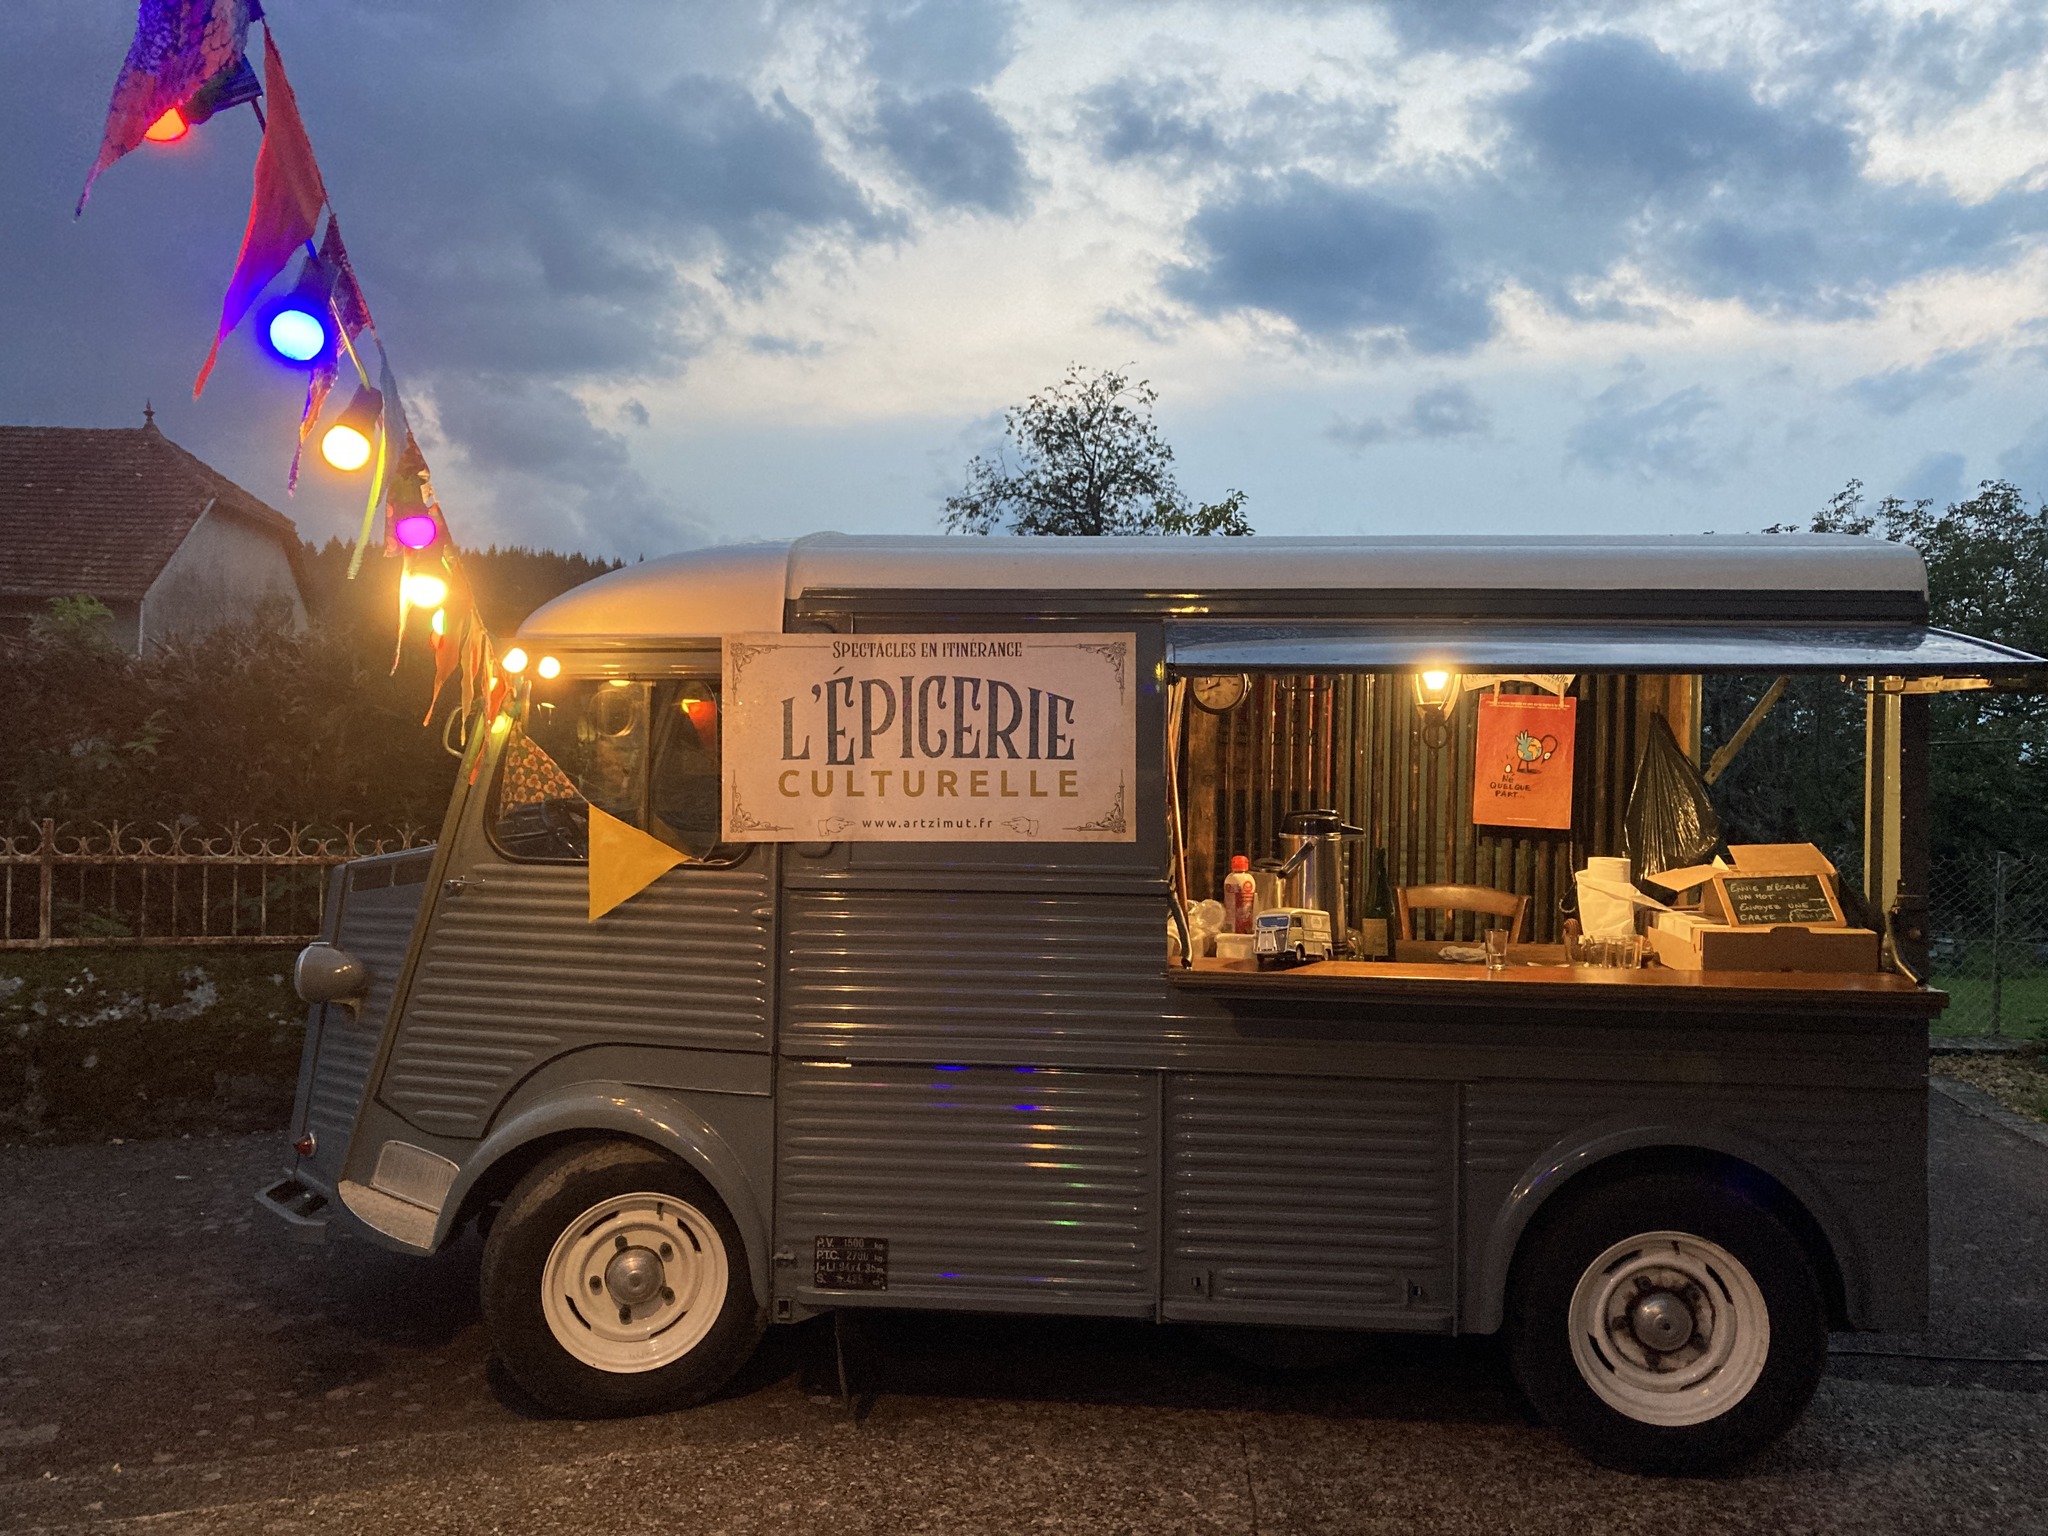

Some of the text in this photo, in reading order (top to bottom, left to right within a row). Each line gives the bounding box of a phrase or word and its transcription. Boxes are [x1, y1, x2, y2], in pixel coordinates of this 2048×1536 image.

[920, 641, 938, 658] EN
[941, 638, 1023, 658] ITINÉRANCE
[780, 666, 1075, 766] L'ÉPICERIE
[778, 769, 1079, 798] CULTURELLE
[1490, 782, 1532, 791] QUELQUE
[862, 817, 994, 830] www.artzimut.fr
[844, 1238, 865, 1248] 1500
